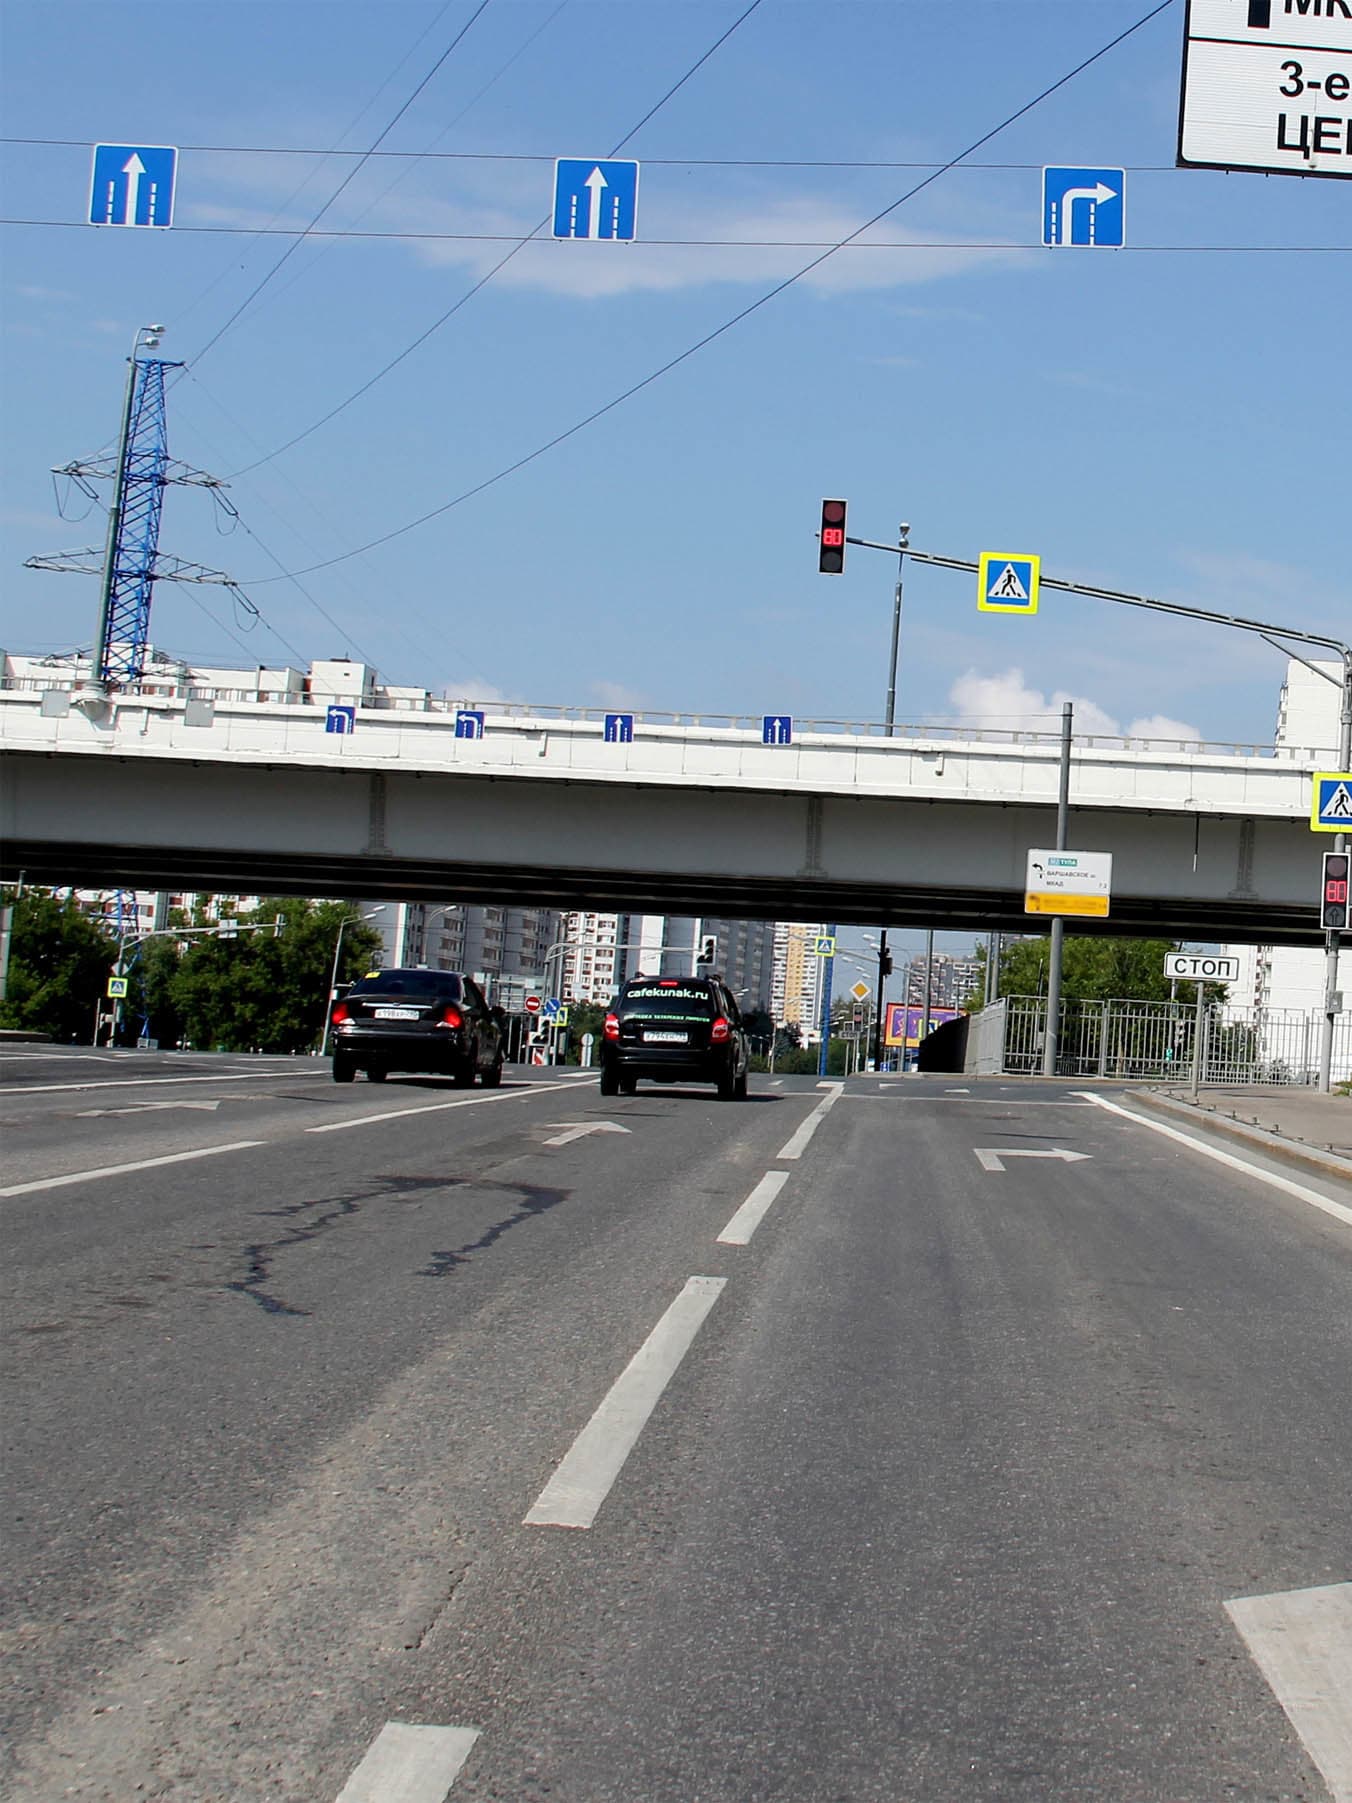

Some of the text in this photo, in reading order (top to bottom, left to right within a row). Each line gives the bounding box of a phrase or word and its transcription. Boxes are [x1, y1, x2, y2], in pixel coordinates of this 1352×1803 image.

[1279, 60, 1350, 101] 3-е
[1327, 880, 1346, 902] 80
[1174, 958, 1230, 977] СТОП
[627, 988, 709, 1000] cafekunak.ru
